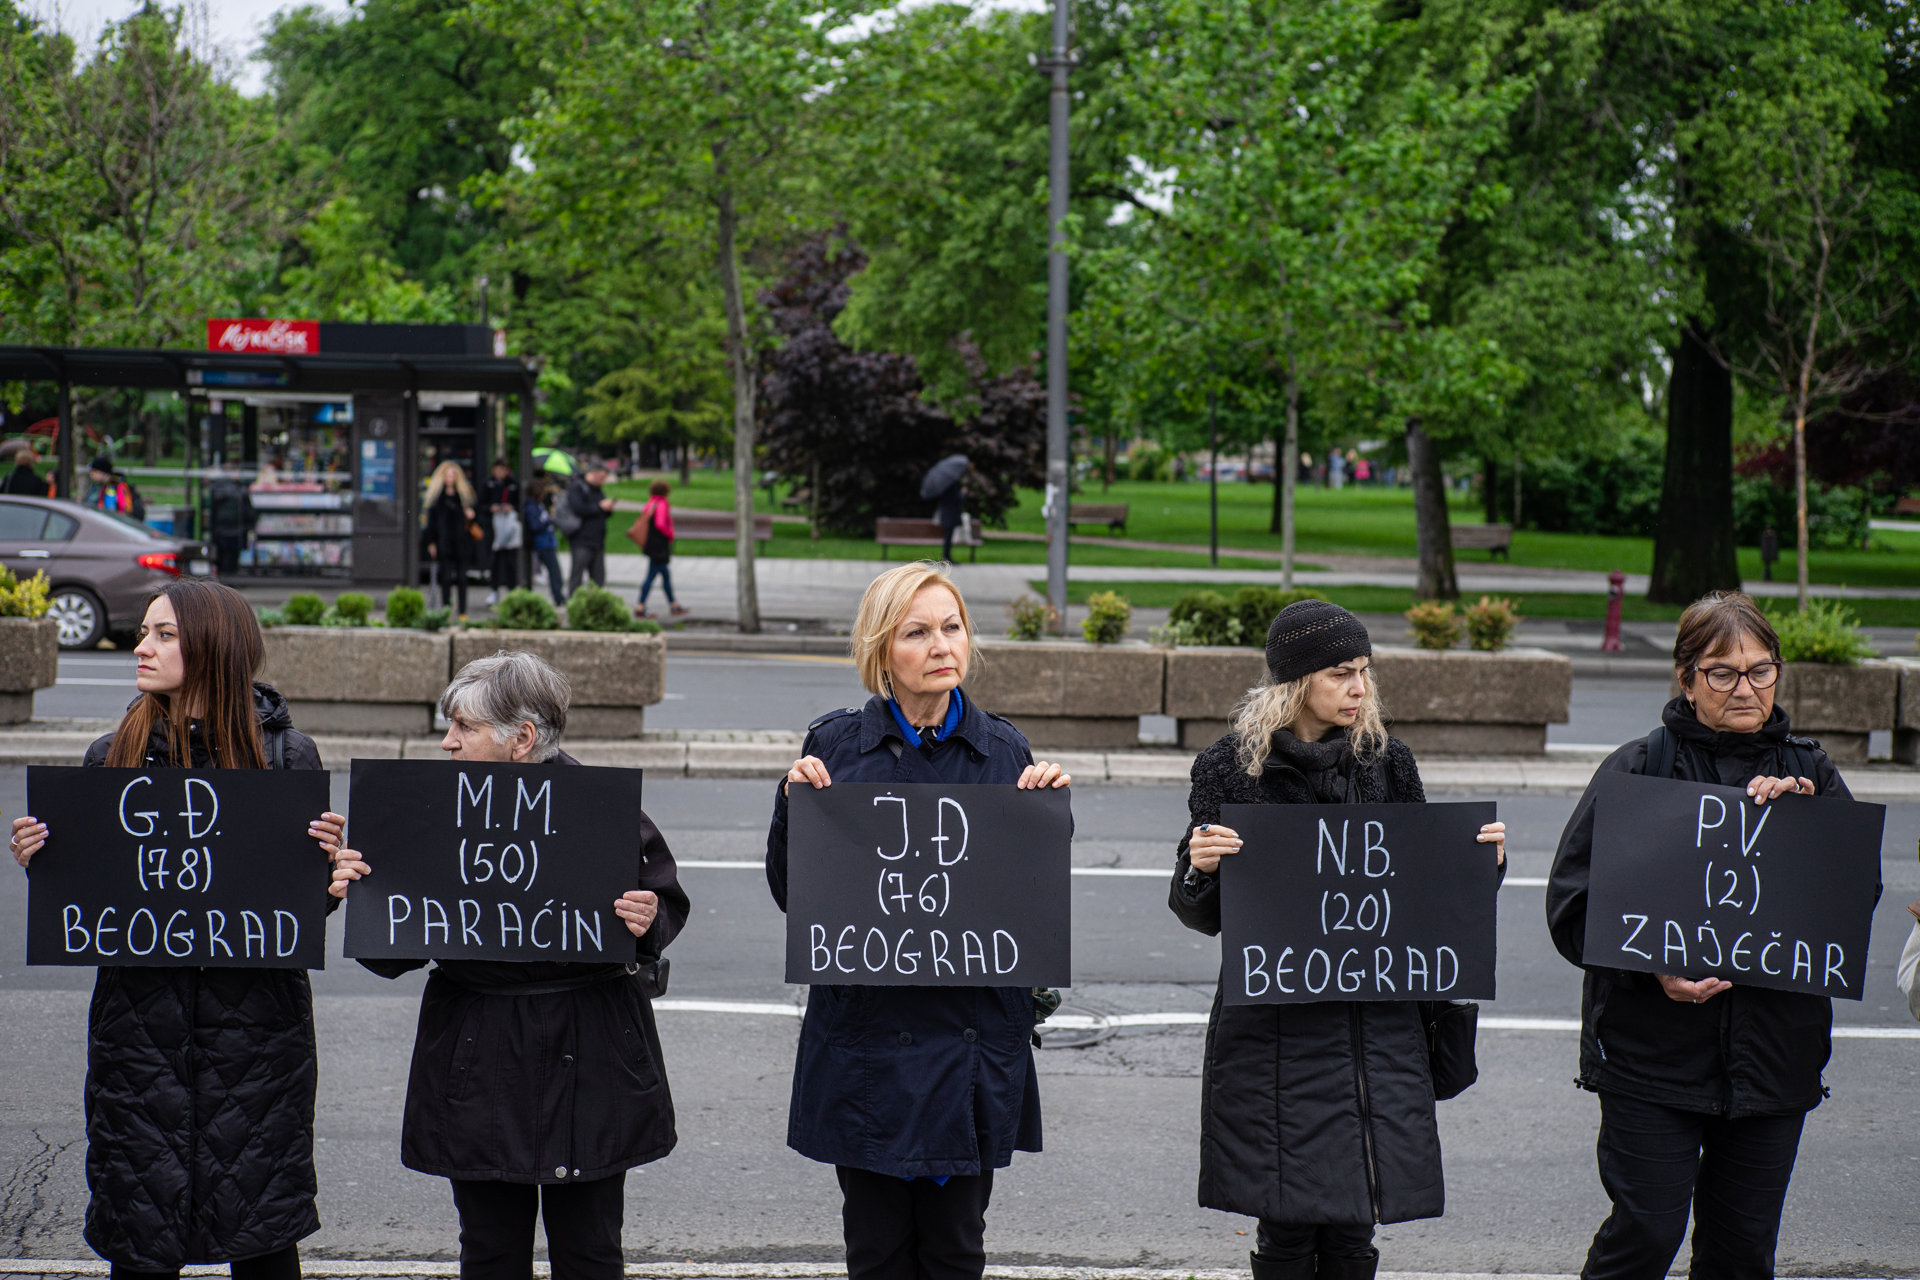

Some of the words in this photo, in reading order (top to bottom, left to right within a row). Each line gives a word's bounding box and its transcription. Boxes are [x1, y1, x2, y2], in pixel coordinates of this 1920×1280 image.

[119, 776, 220, 838] G.Đ.
[457, 771, 557, 835] M.M.
[874, 791, 969, 866] J.Đ.
[1697, 794, 1772, 857] P.V.
[138, 844, 212, 892] (78)
[460, 838, 538, 891] (50)
[1318, 818, 1396, 877] N.B.
[878, 868, 950, 918] (76)
[1322, 888, 1391, 937] (20)
[1705, 860, 1761, 915] (2)
[63, 904, 299, 959] BEOGRAD
[811, 923, 1019, 977] BEOGRAD
[1621, 914, 1849, 988] ZAJEČAR
[1243, 945, 1459, 997] BEOGRAD
